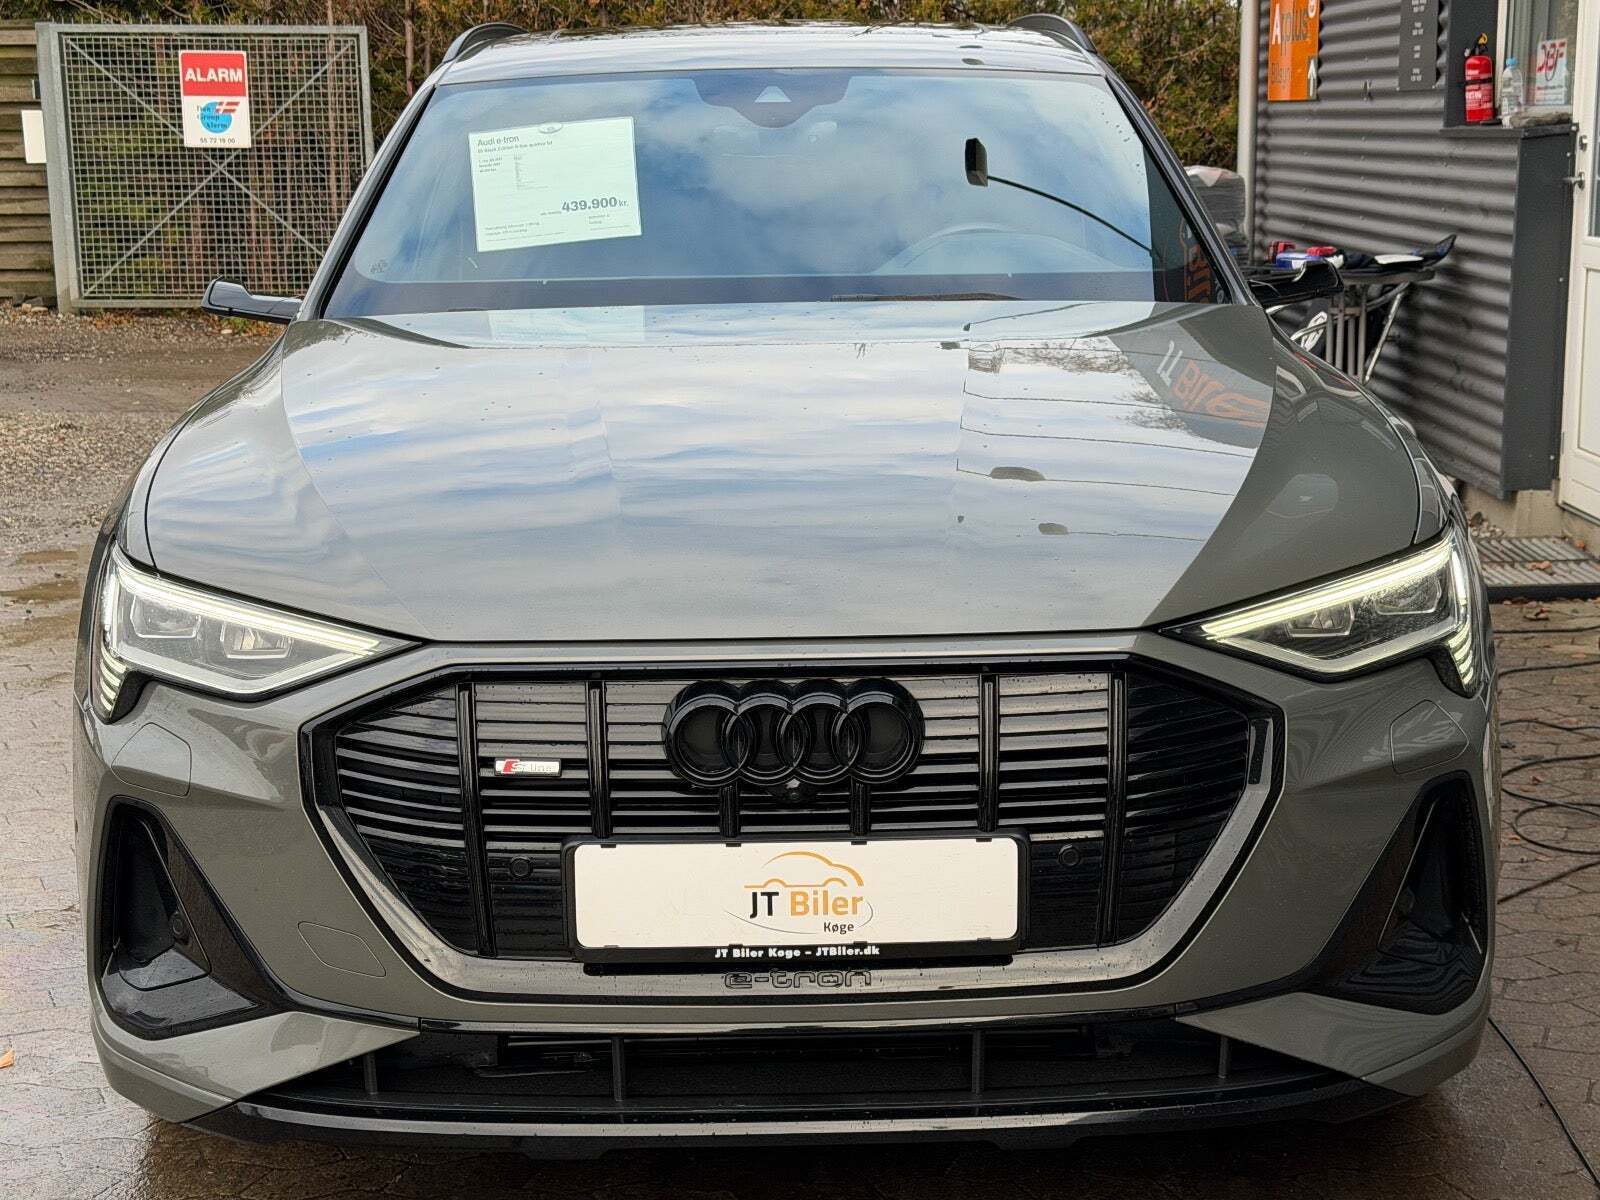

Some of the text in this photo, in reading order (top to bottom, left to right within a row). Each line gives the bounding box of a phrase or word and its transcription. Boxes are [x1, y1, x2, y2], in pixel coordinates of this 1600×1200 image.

[185, 67, 243, 83] ALARM
[477, 135, 520, 147] Audi e-tron
[561, 196, 618, 213] 439.900
[618, 199, 630, 208] kr.
[749, 889, 864, 919] JT Biler
[823, 921, 855, 935] Køge
[714, 949, 729, 959] JT
[732, 948, 764, 958] Biler
[815, 945, 880, 957] JTBiler.dk
[724, 970, 872, 989] e-tron
